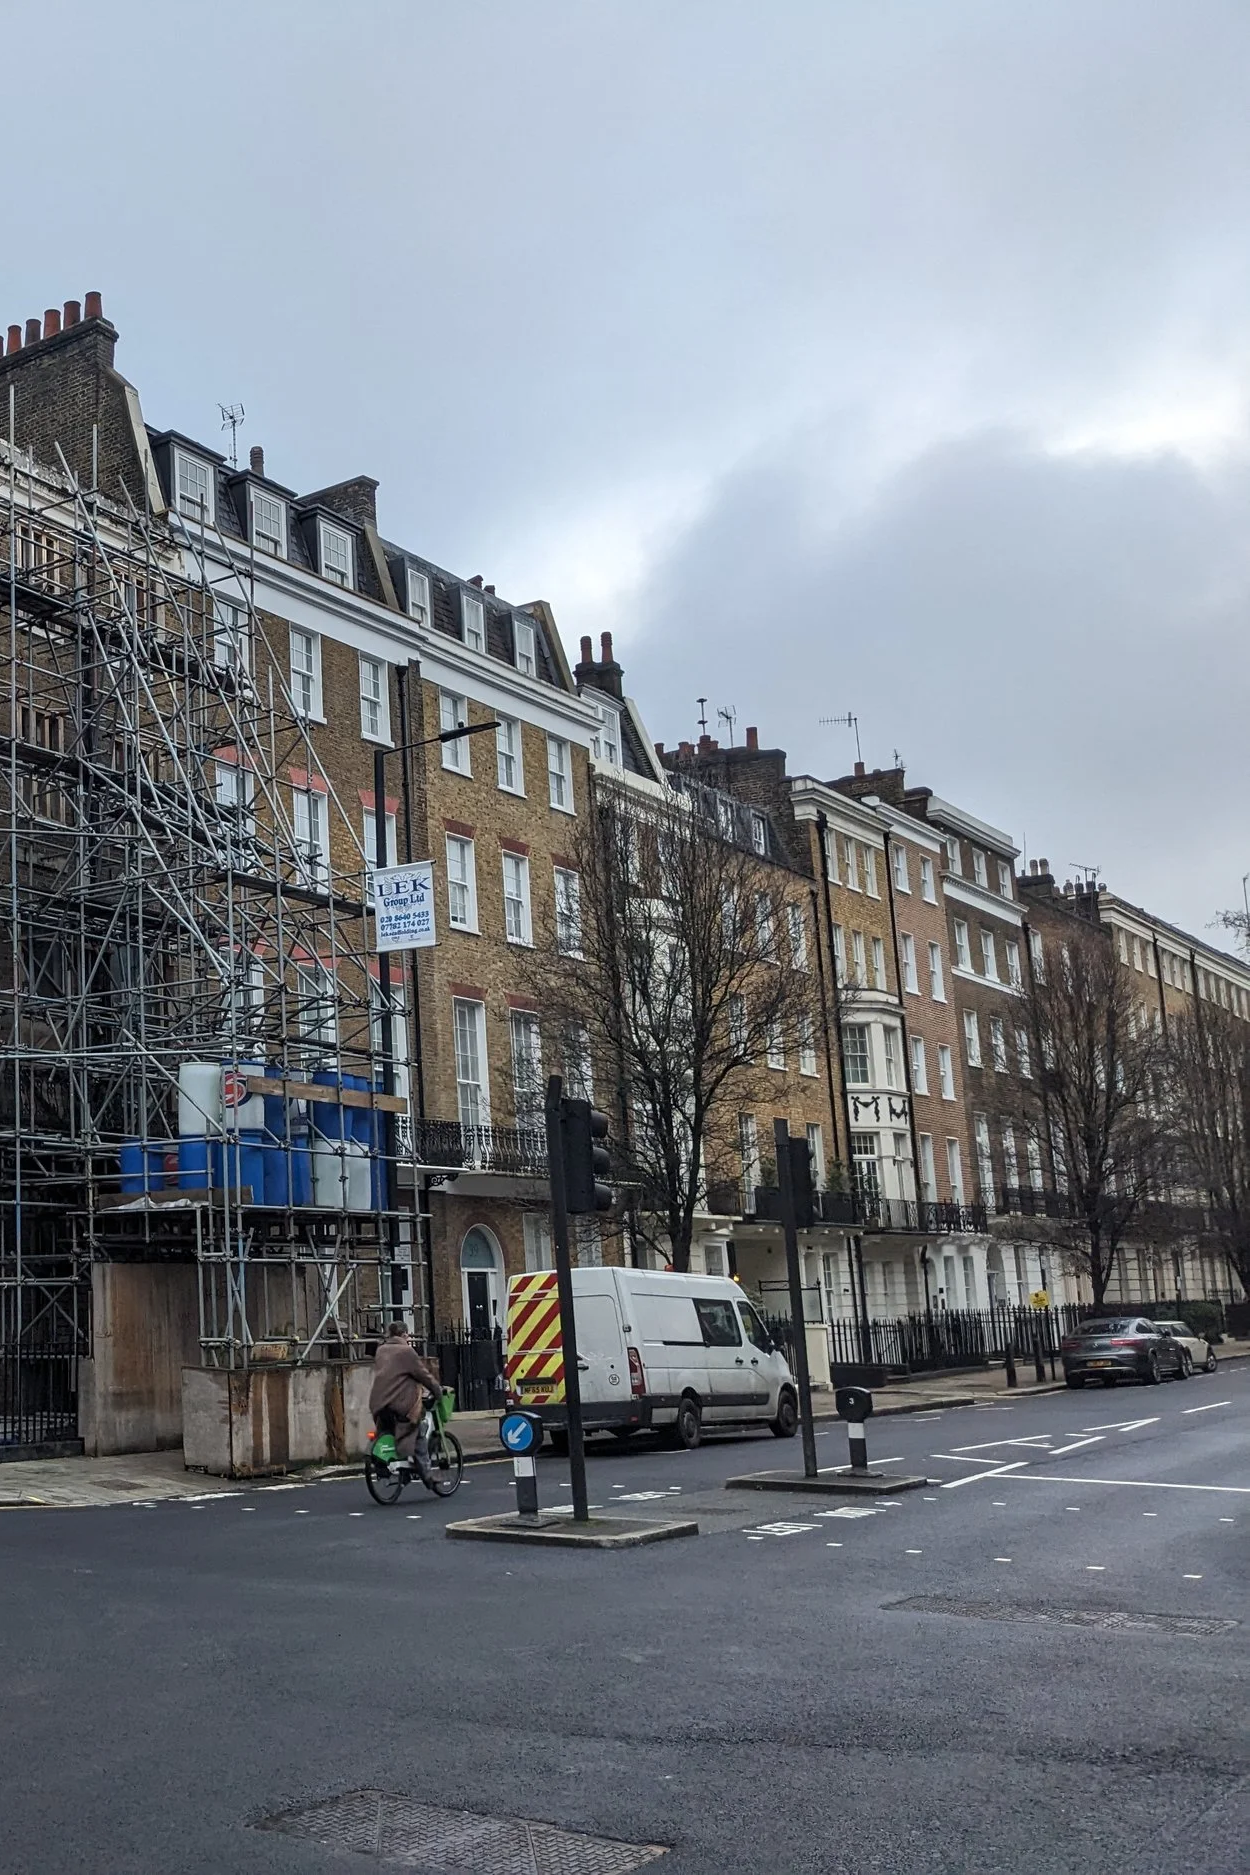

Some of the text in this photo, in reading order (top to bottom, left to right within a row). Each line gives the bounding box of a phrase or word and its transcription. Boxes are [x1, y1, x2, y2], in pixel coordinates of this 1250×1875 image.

[376, 877, 431, 897] LEK
[383, 892, 424, 907] Group Ltd
[417, 918, 430, 926] 027
[849, 1397, 855, 1405] 3
